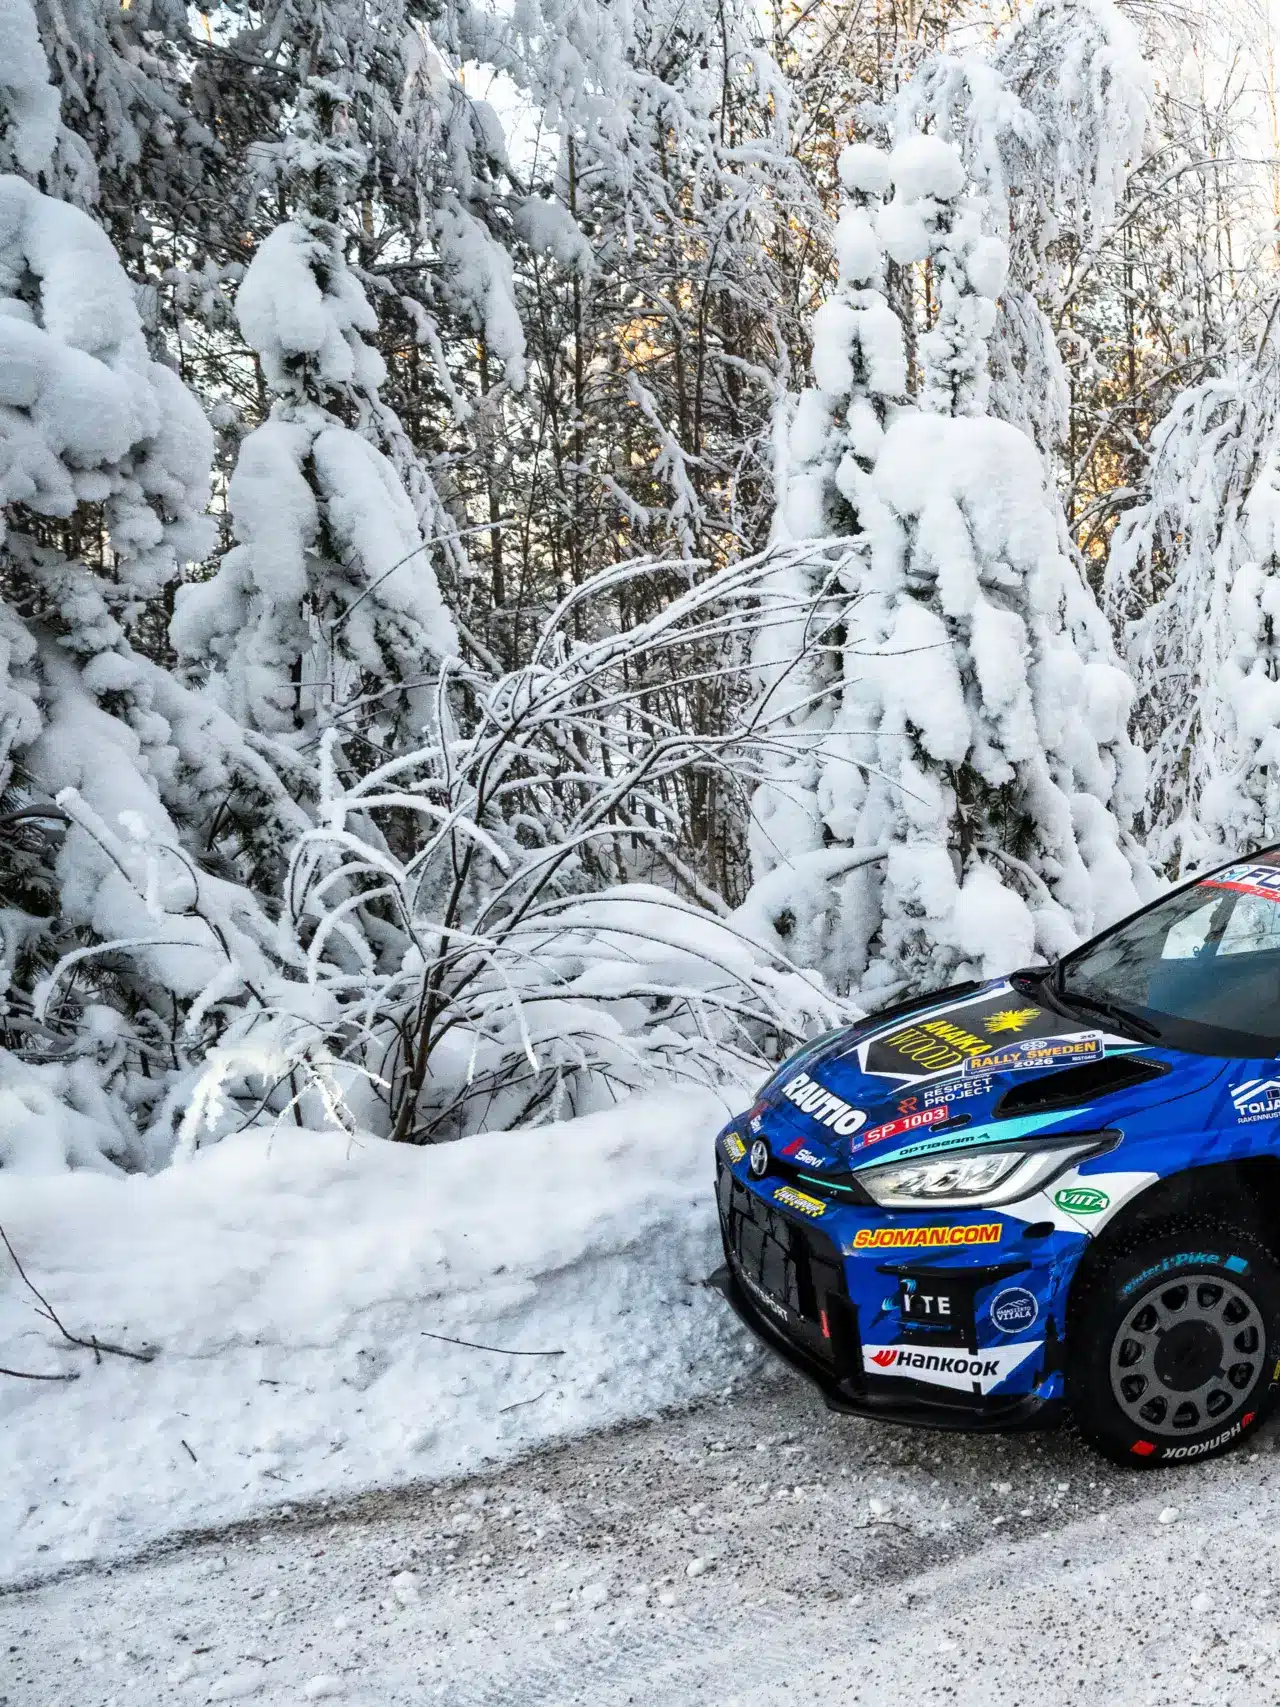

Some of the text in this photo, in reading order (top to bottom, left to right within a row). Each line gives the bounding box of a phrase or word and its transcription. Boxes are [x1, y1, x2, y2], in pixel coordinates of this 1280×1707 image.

[883, 1028, 963, 1069] WOOD
[918, 1020, 993, 1056] ANAIKA
[971, 1041, 1096, 1070] RALLY SWEDEN
[1013, 1058, 1054, 1068] 2026
[924, 1078, 993, 1099] RESPECT
[924, 1086, 994, 1108] PROJECT
[781, 1072, 867, 1136] RAUTIO
[867, 1109, 945, 1142] SP 1003
[1059, 1191, 1108, 1209] VIITA
[854, 1224, 1001, 1248] SJOMAN.COM
[997, 1311, 1033, 1321] VIIALA
